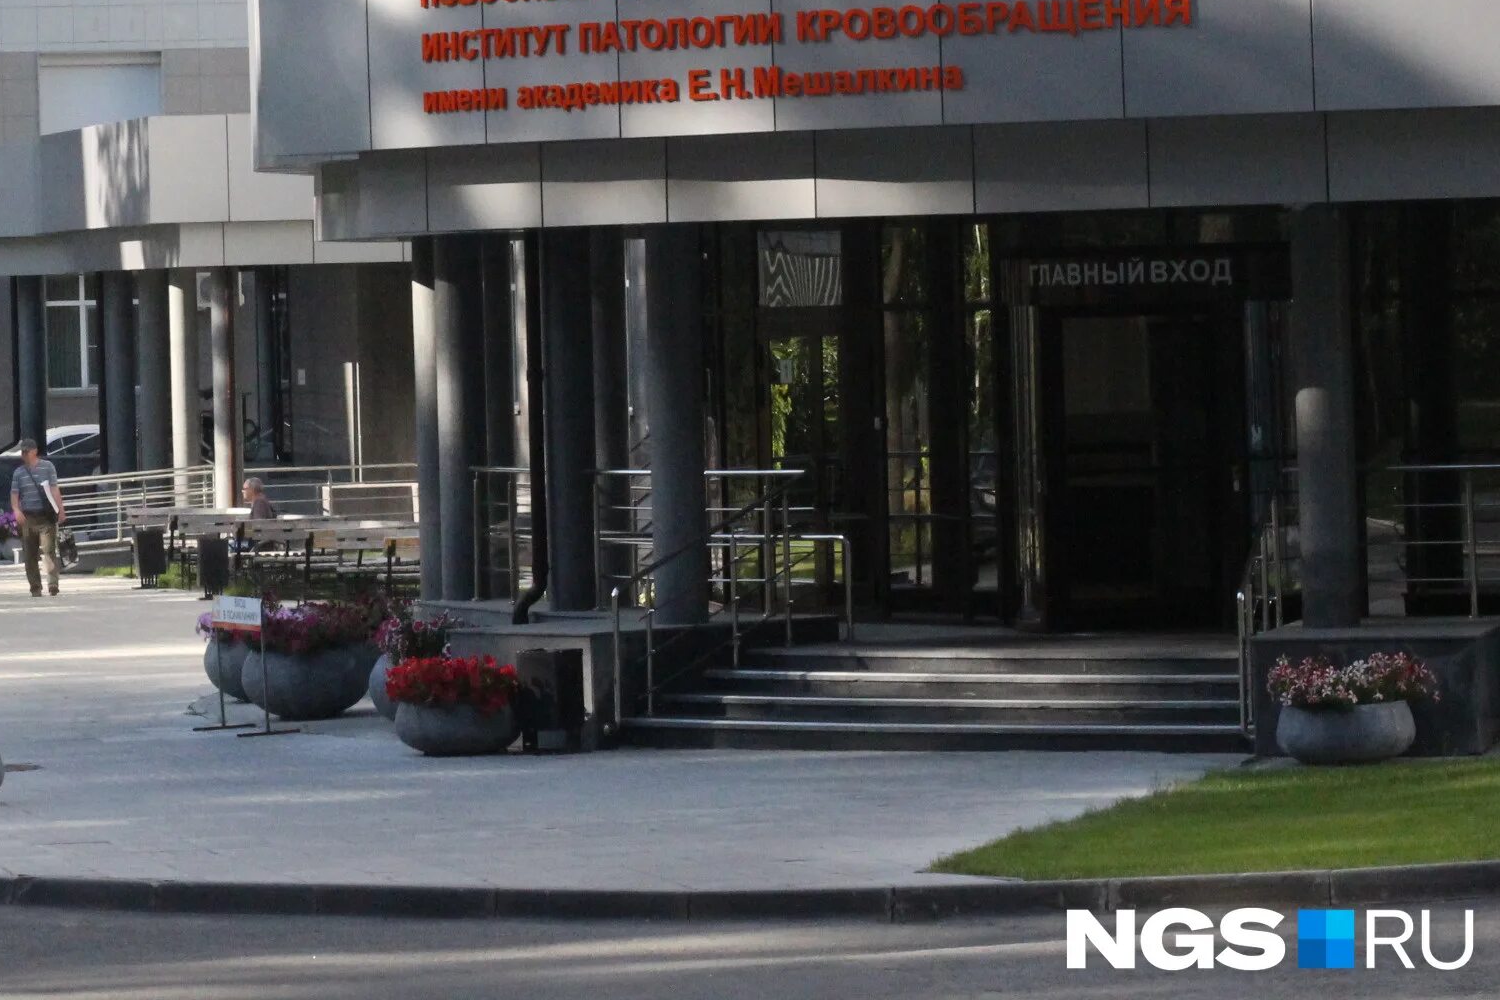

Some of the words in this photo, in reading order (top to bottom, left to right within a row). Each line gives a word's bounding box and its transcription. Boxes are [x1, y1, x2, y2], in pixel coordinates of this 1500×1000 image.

[421, 23, 571, 63] ИНСТИТУТ
[578, 12, 783, 55] ПАТОЛОГИИ
[423, 87, 508, 113] имени
[516, 77, 681, 112] академика
[1028, 256, 1145, 287] ГЛАВНЫЙ
[1149, 258, 1233, 286] ВХОД
